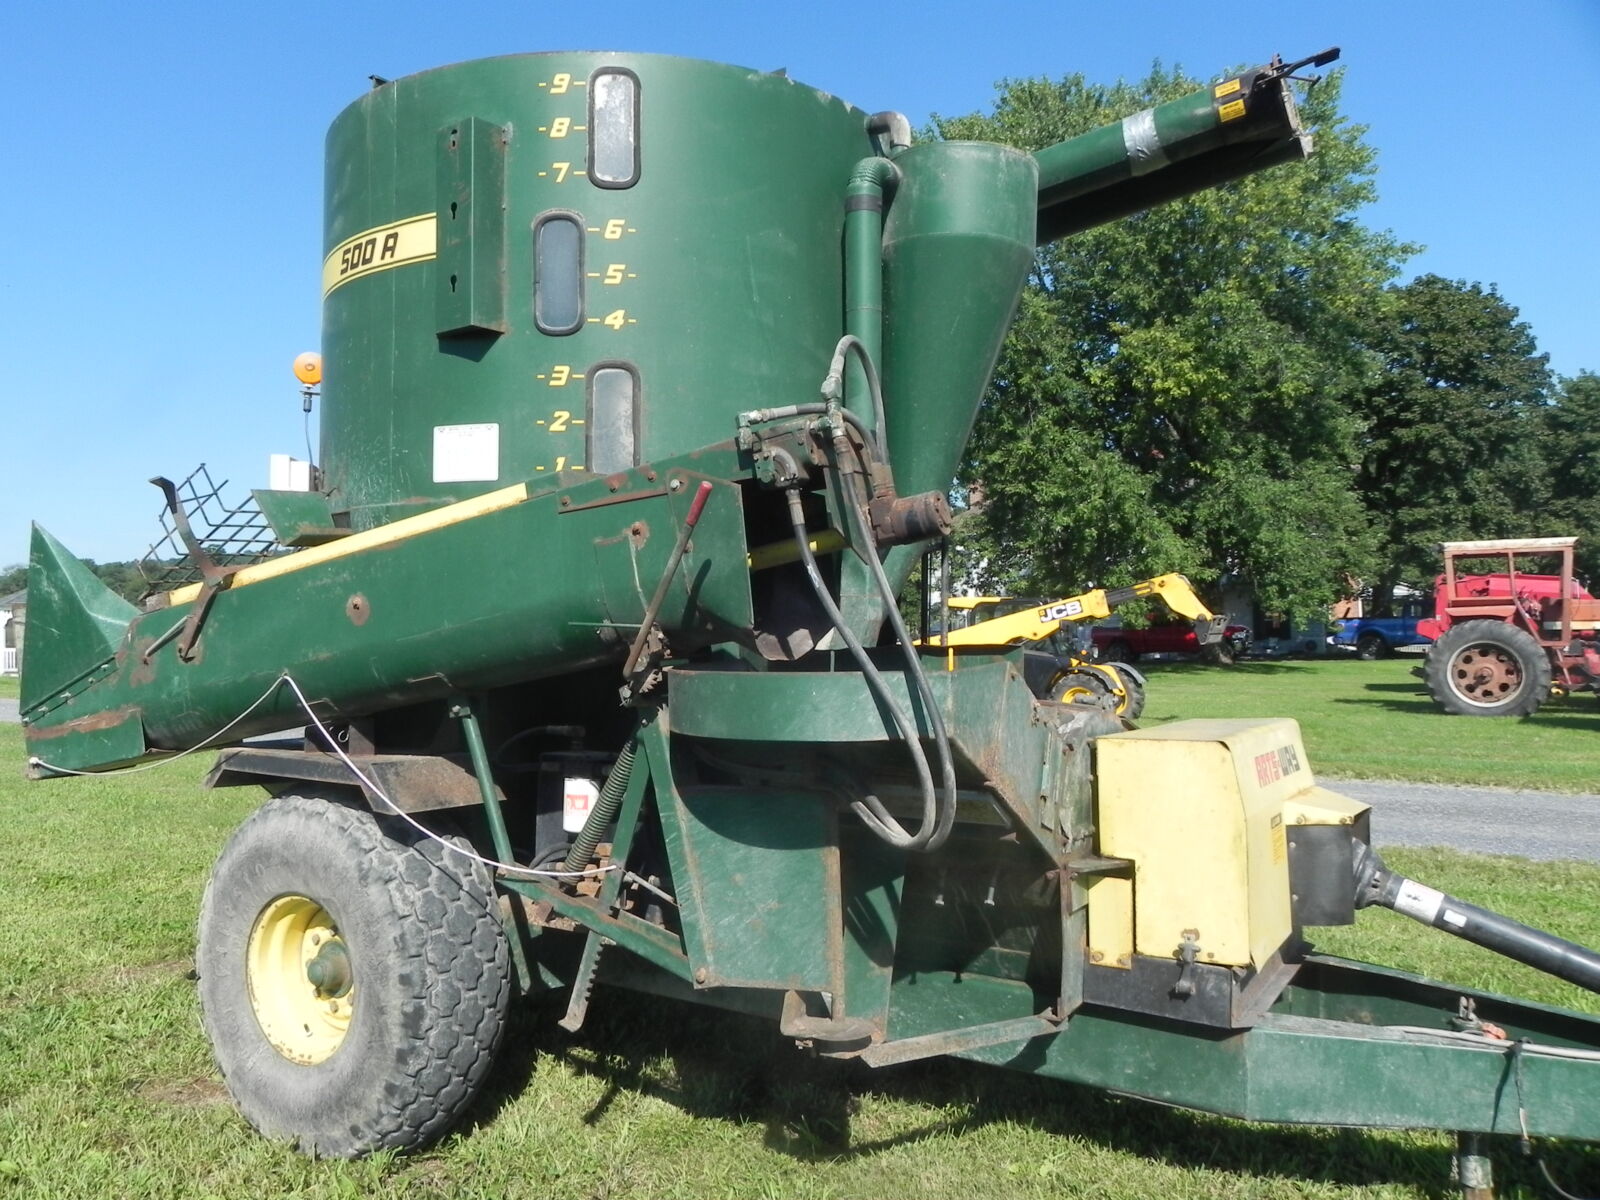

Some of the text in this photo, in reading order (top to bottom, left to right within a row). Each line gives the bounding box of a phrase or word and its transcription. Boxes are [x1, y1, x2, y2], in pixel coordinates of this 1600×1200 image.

[340, 231, 399, 276] 500 A
[1040, 600, 1082, 623] JCB
